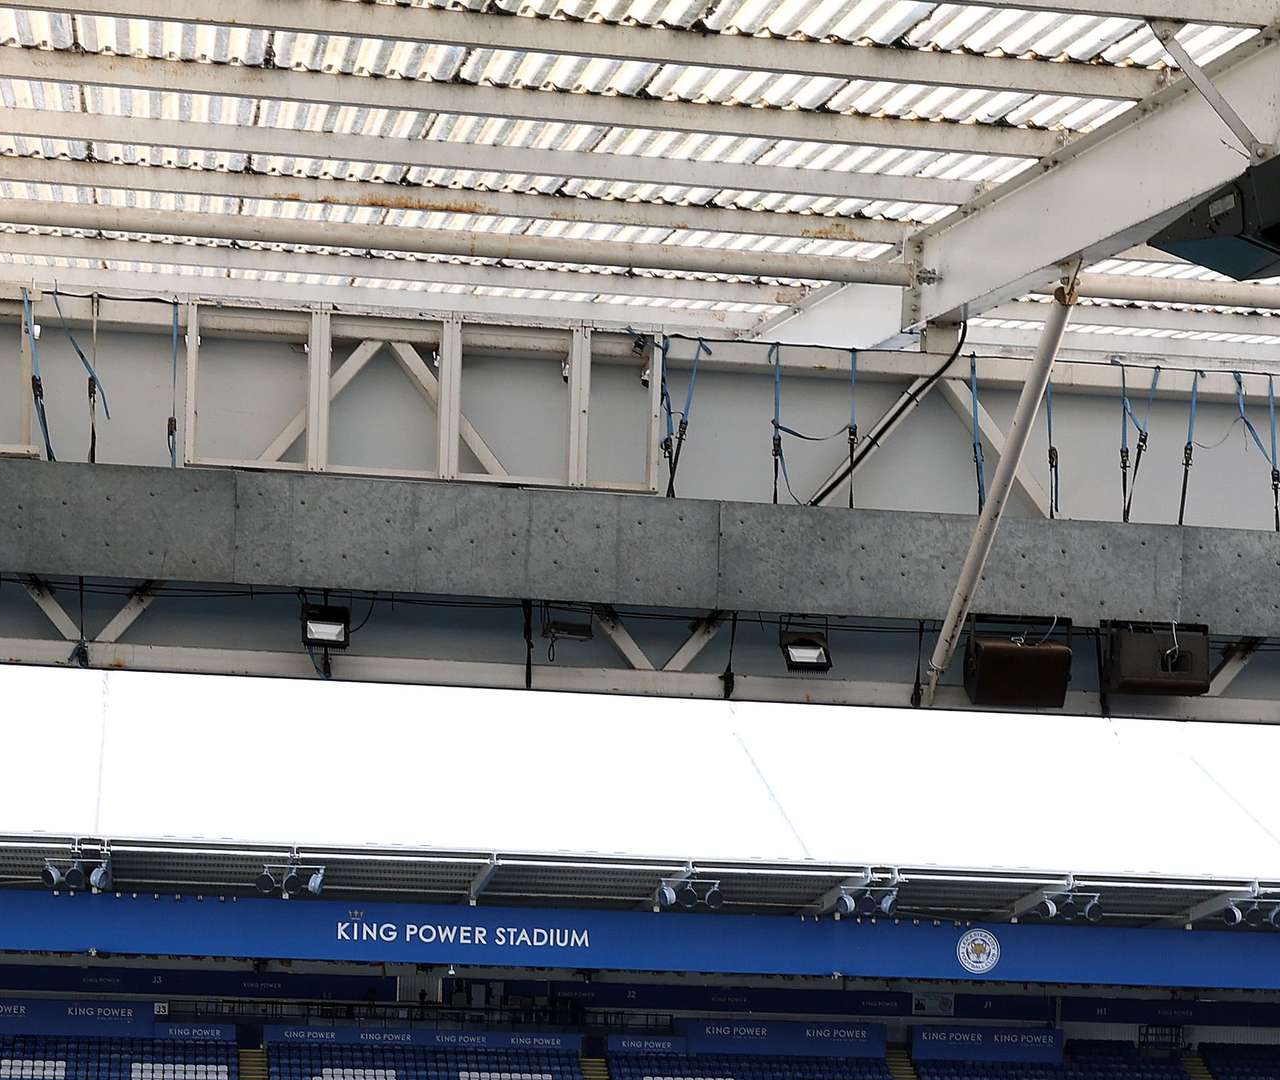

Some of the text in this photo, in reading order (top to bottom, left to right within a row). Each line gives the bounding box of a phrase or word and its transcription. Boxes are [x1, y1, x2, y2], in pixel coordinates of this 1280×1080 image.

[338, 923, 589, 947] KING POWER STADIUM
[68, 1008, 133, 1017] KING POWER
[193, 1029, 221, 1037] POWER
[706, 1027, 767, 1036] KING POWER
[806, 1030, 866, 1039] KING POWER
[923, 1032, 982, 1041] KING POWER
[1021, 1035, 1053, 1043] POWER
[644, 1041, 671, 1049] POWER
